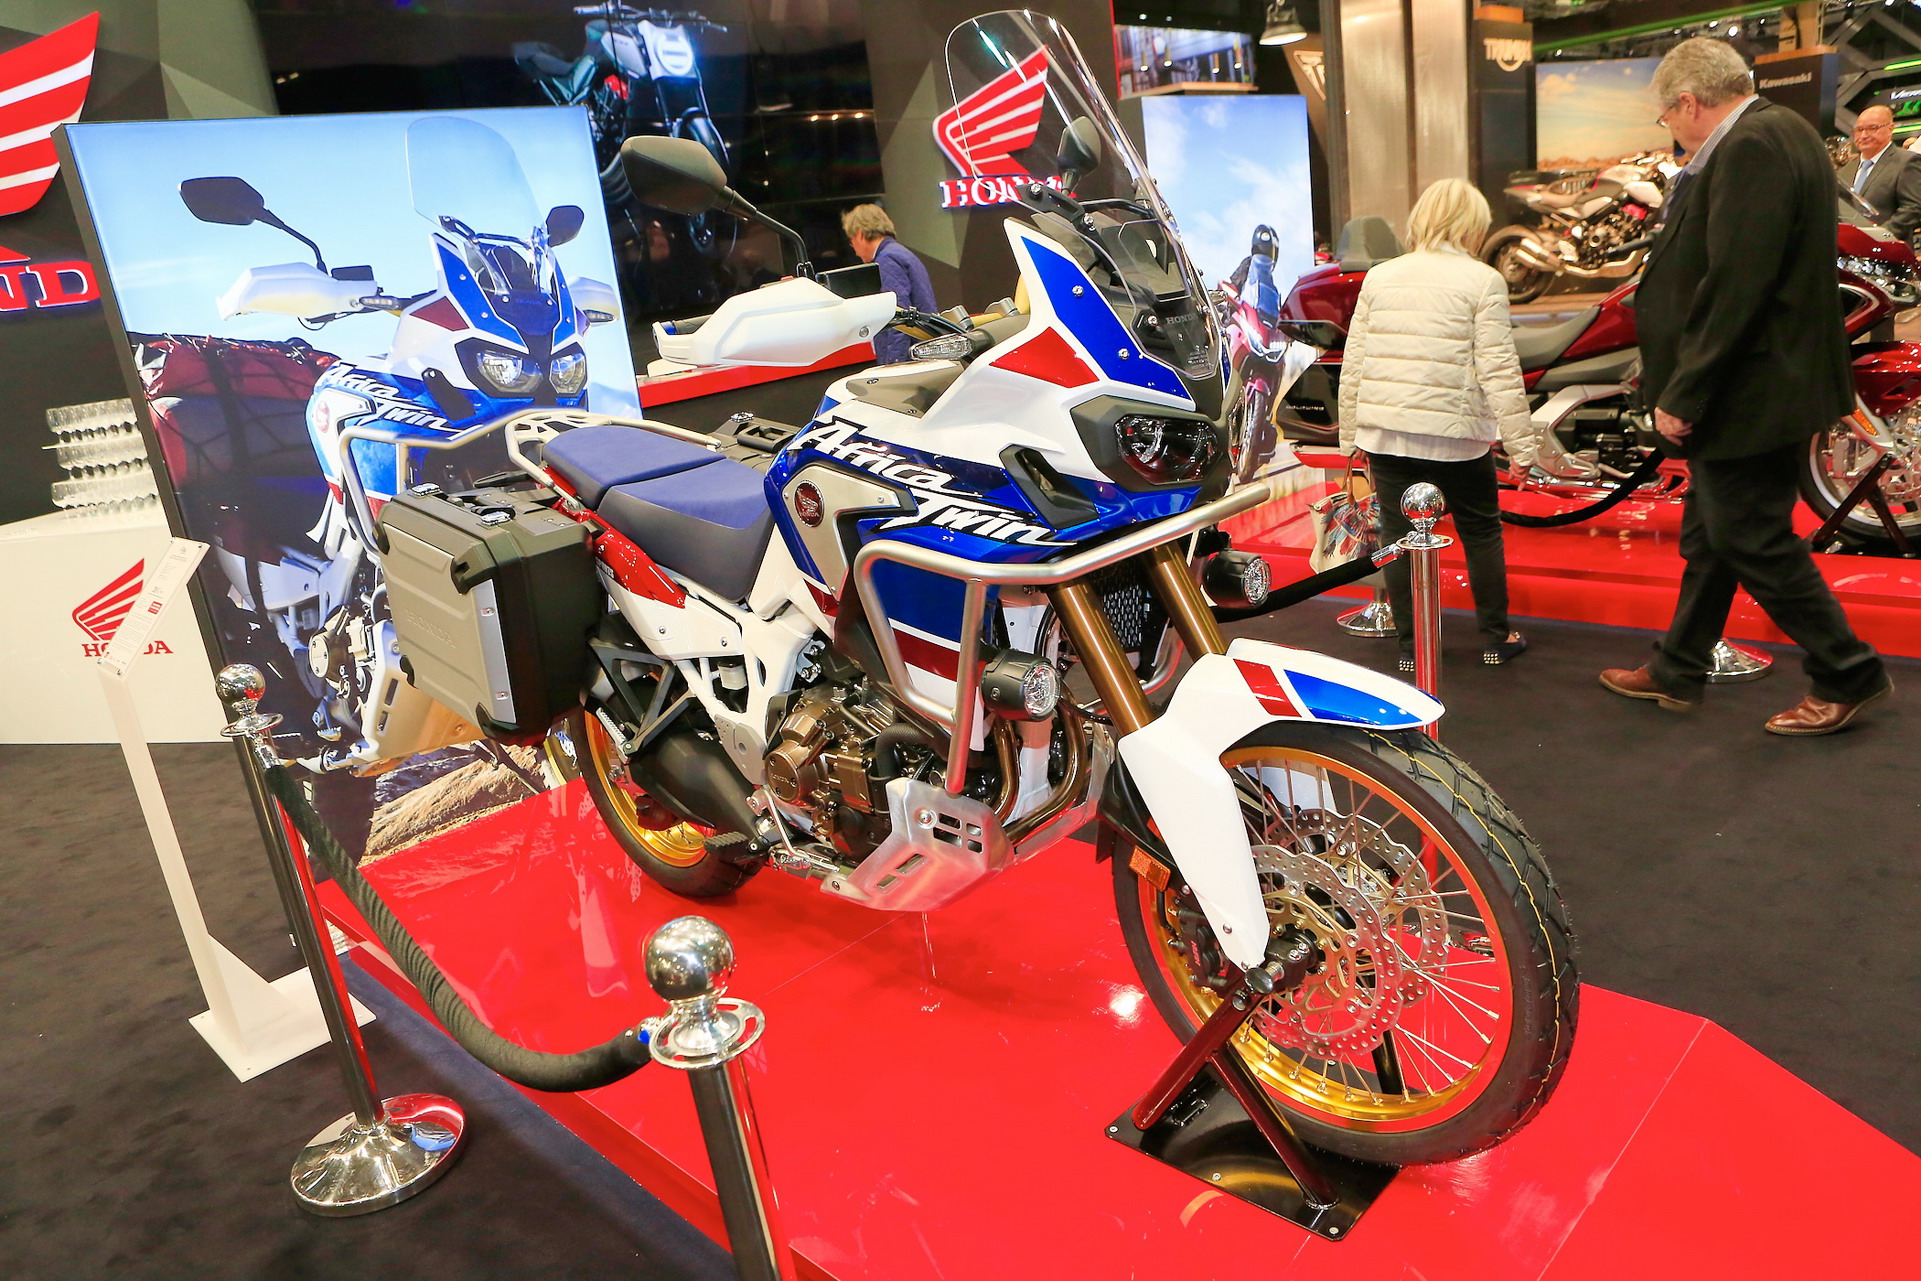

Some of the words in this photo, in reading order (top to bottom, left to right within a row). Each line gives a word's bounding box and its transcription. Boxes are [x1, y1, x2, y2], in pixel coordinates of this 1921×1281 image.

[1759, 72, 1812, 89] Kawasaki
[355, 397, 466, 434] Twin
[787, 417, 984, 498] Africa
[880, 487, 1079, 547] Twin
